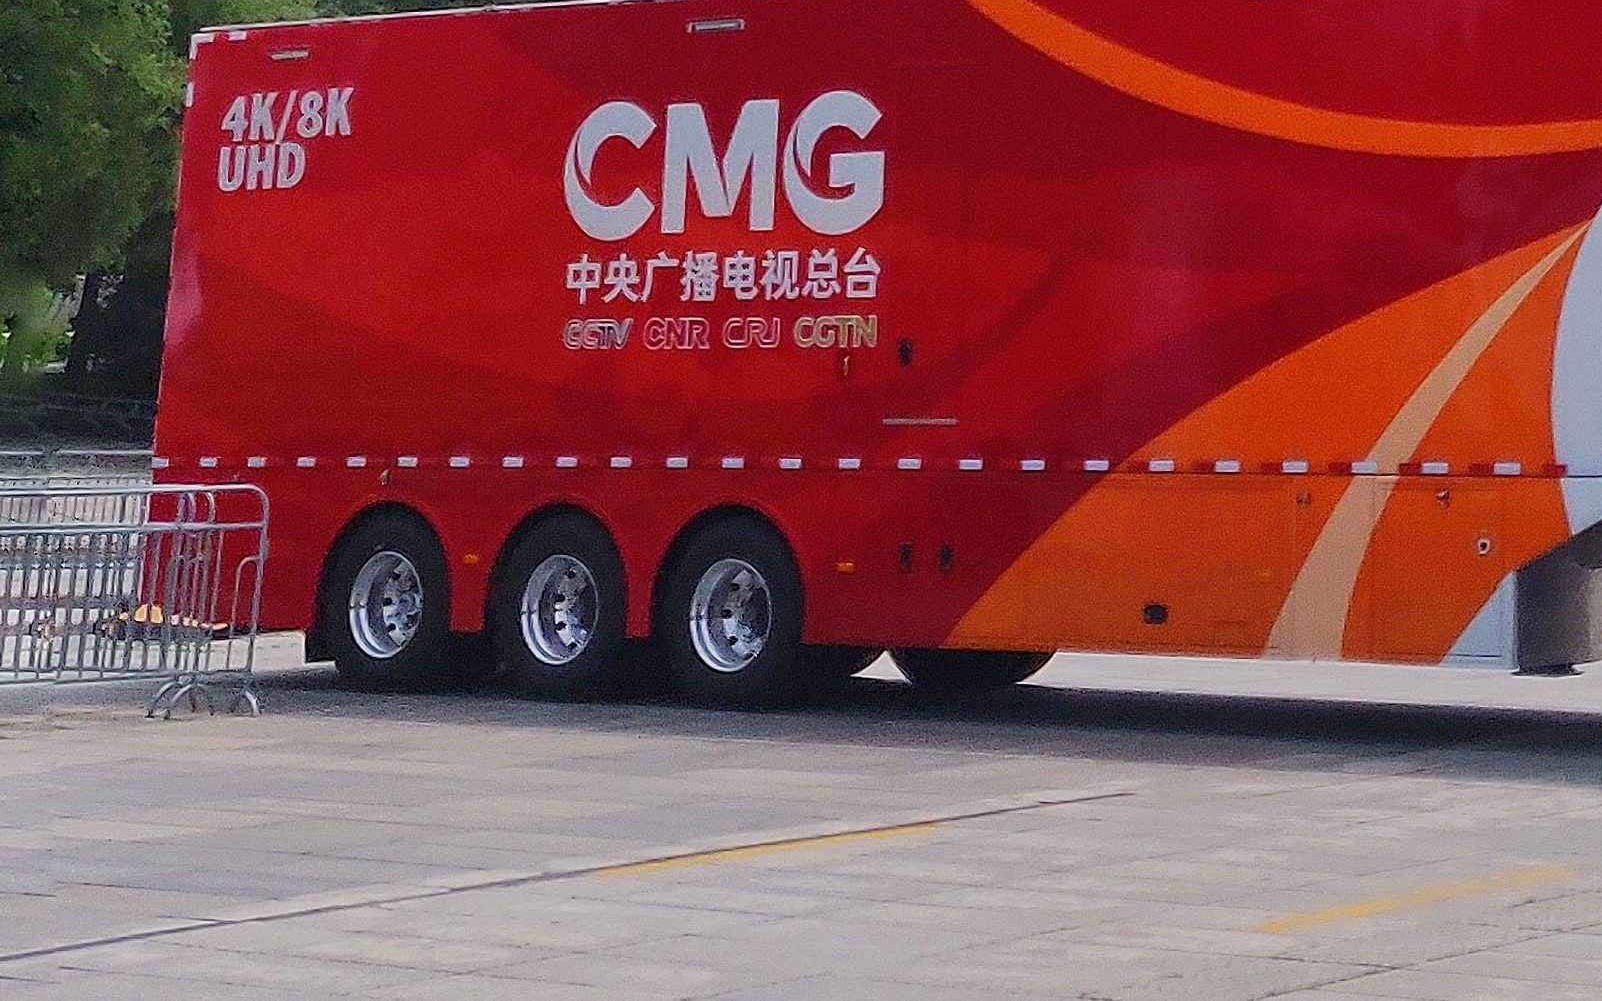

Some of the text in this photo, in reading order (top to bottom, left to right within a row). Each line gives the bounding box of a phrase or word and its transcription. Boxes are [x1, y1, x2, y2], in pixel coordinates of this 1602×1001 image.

[220, 86, 355, 144] 4K/8K
[217, 142, 306, 192] UHD
[563, 89, 885, 241] CMG
[565, 247, 881, 303] 中央广播电视总台
[563, 317, 634, 349] CCTV
[643, 316, 710, 349] CNR
[793, 314, 879, 349] CGTN
